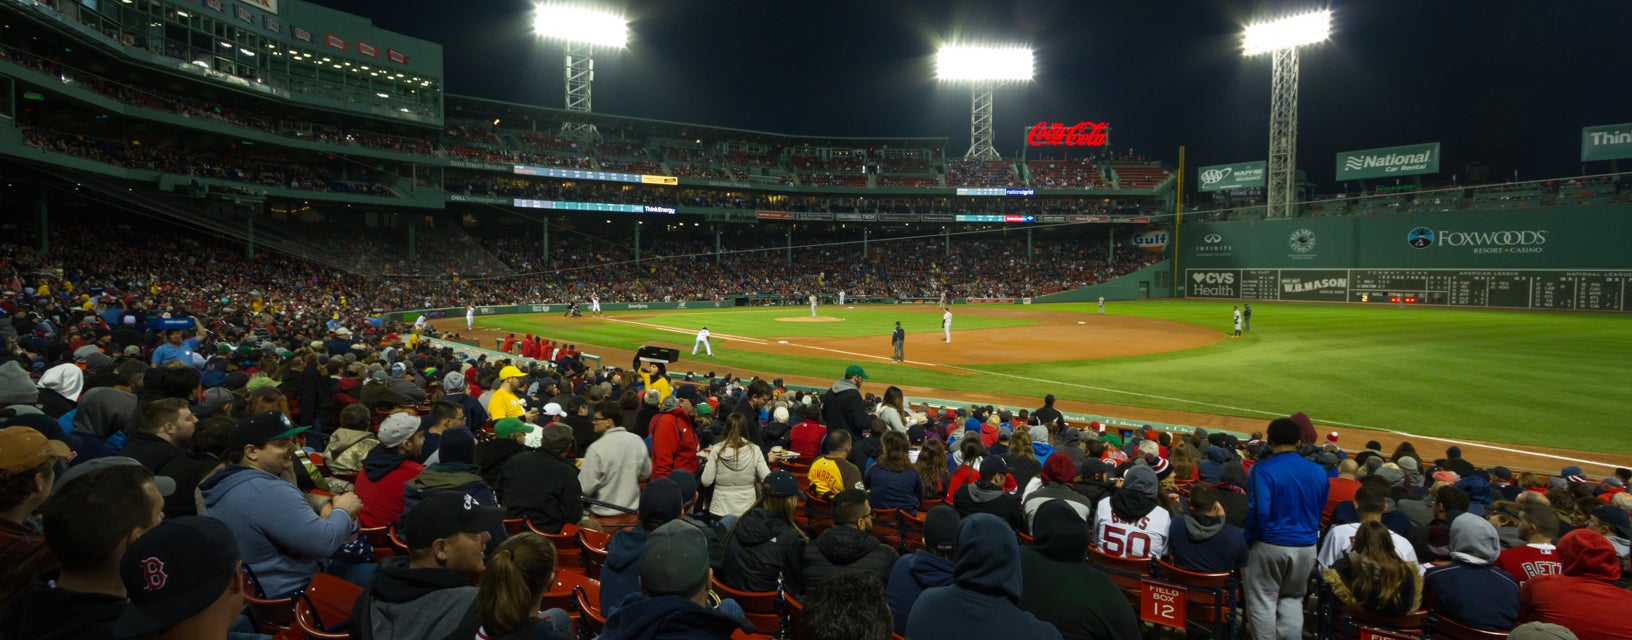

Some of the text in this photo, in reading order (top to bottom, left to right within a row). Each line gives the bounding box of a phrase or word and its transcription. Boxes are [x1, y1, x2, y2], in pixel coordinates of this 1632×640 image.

[1590, 130, 1632, 146] Thin
[1400, 163, 1427, 171] Rental
[1202, 169, 1222, 182] AAA
[1134, 233, 1166, 244] Gulf
[1438, 230, 1547, 247] FOXWOODS
[1205, 272, 1235, 284] CVS
[1193, 284, 1234, 297] Health
[1103, 524, 1151, 558] 50
[140, 556, 169, 593] B
[1149, 585, 1179, 597] FIELD
[1153, 592, 1175, 604] BOX
[1154, 602, 1175, 619] 12
